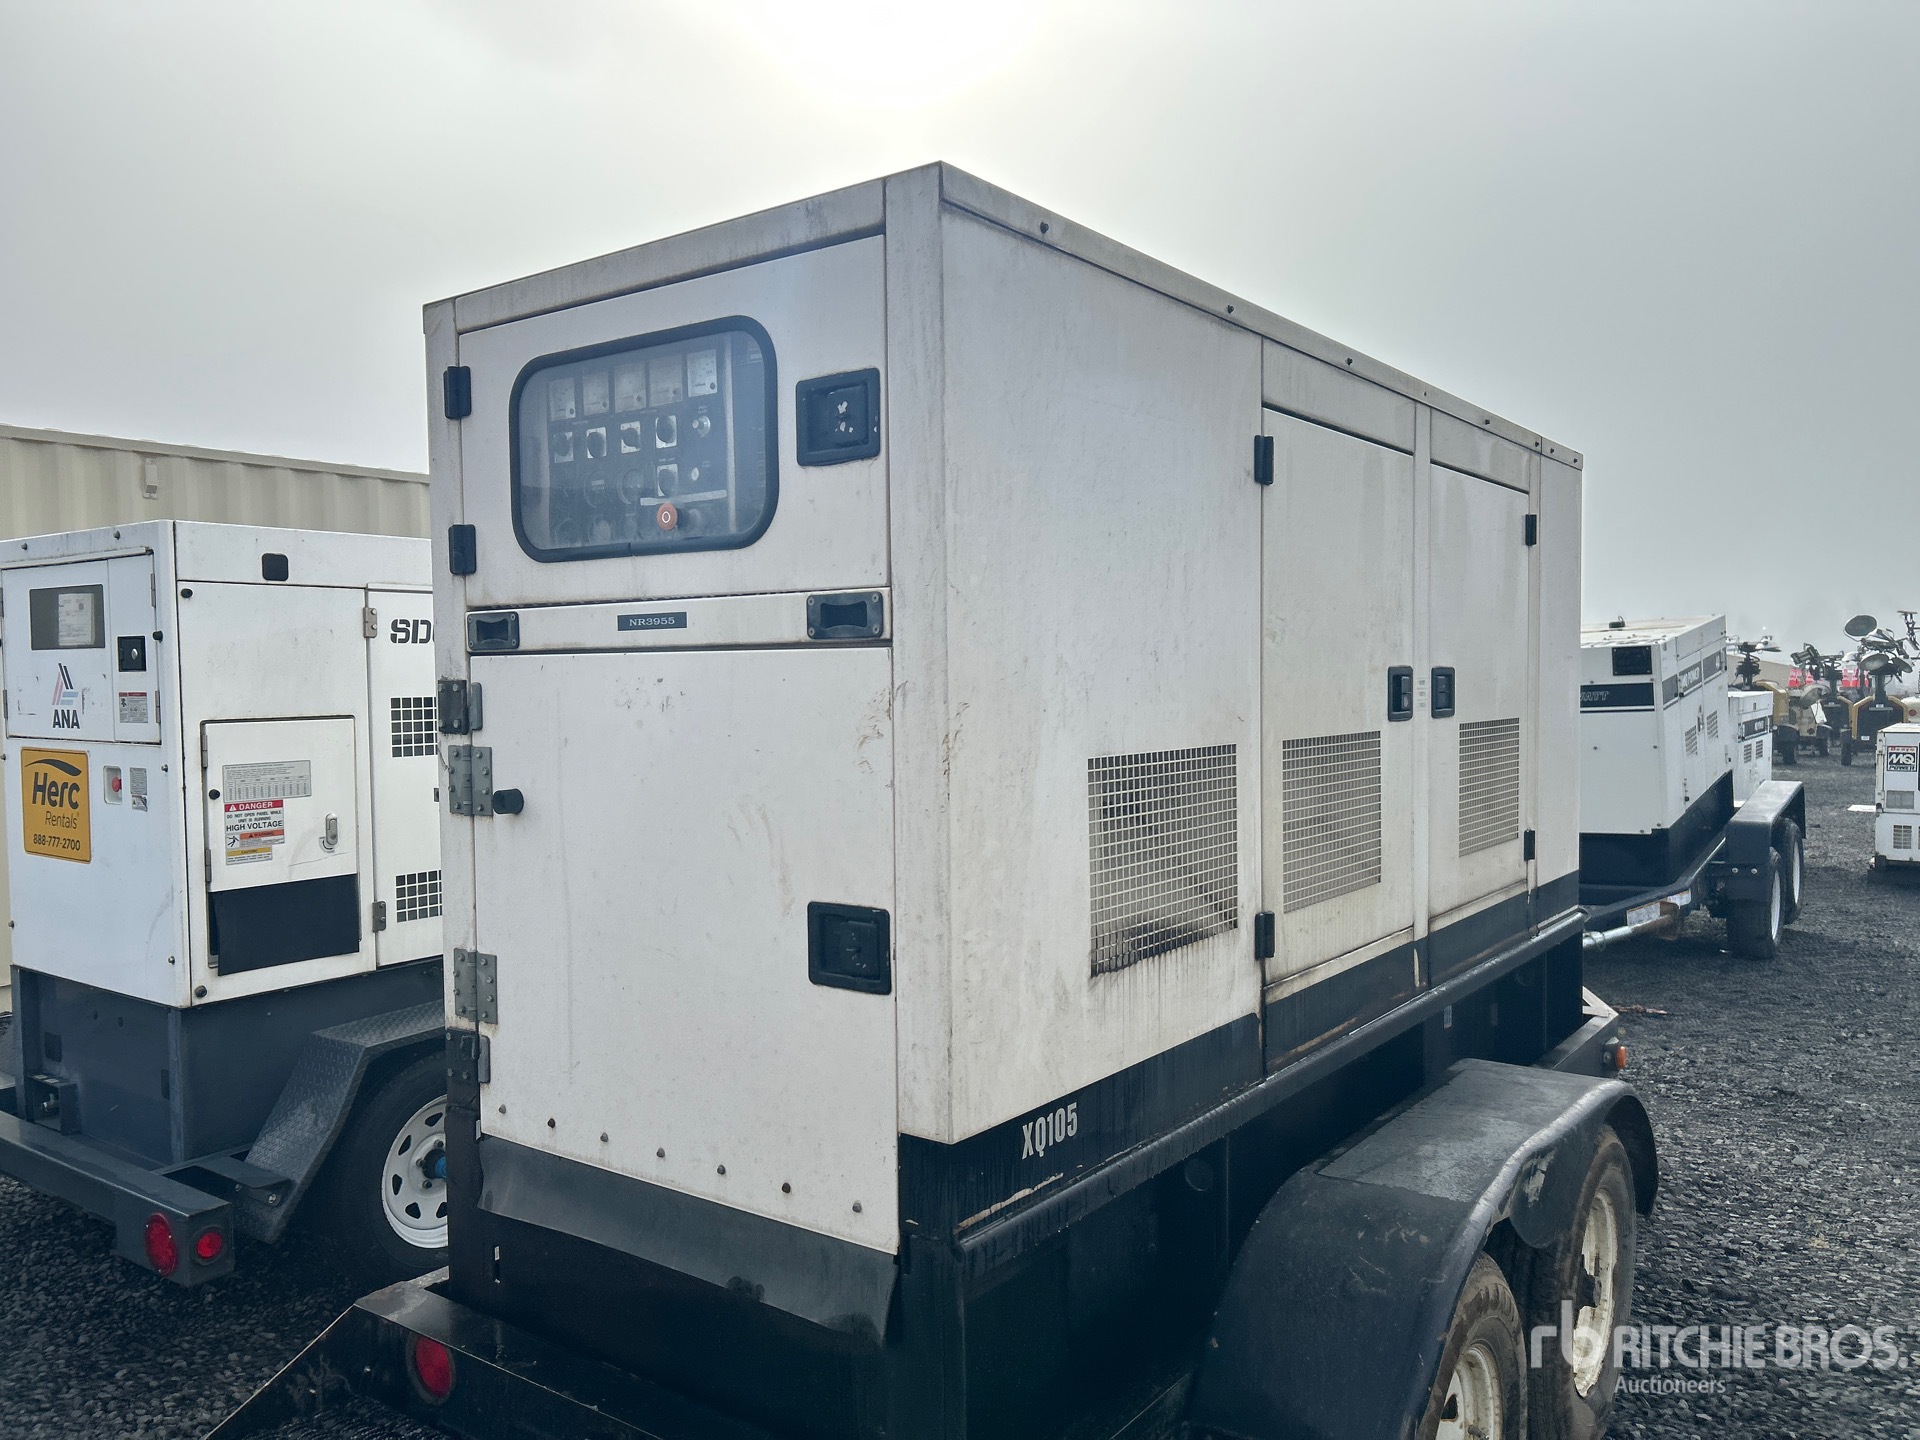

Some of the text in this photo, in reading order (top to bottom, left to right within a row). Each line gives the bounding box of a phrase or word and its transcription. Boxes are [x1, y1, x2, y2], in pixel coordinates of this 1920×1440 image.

[629, 616, 675, 626] NR3955
[390, 619, 434, 644] SD
[52, 709, 80, 729] ANA
[1889, 753, 1915, 765] MQ
[32, 772, 80, 809] Herc
[239, 801, 273, 811] DANGER
[45, 811, 78, 830] Rentals
[226, 820, 283, 832] HIGH VOLTAGE
[33, 833, 81, 851] 888-777-2700
[1022, 1102, 1078, 1160] XQ105
